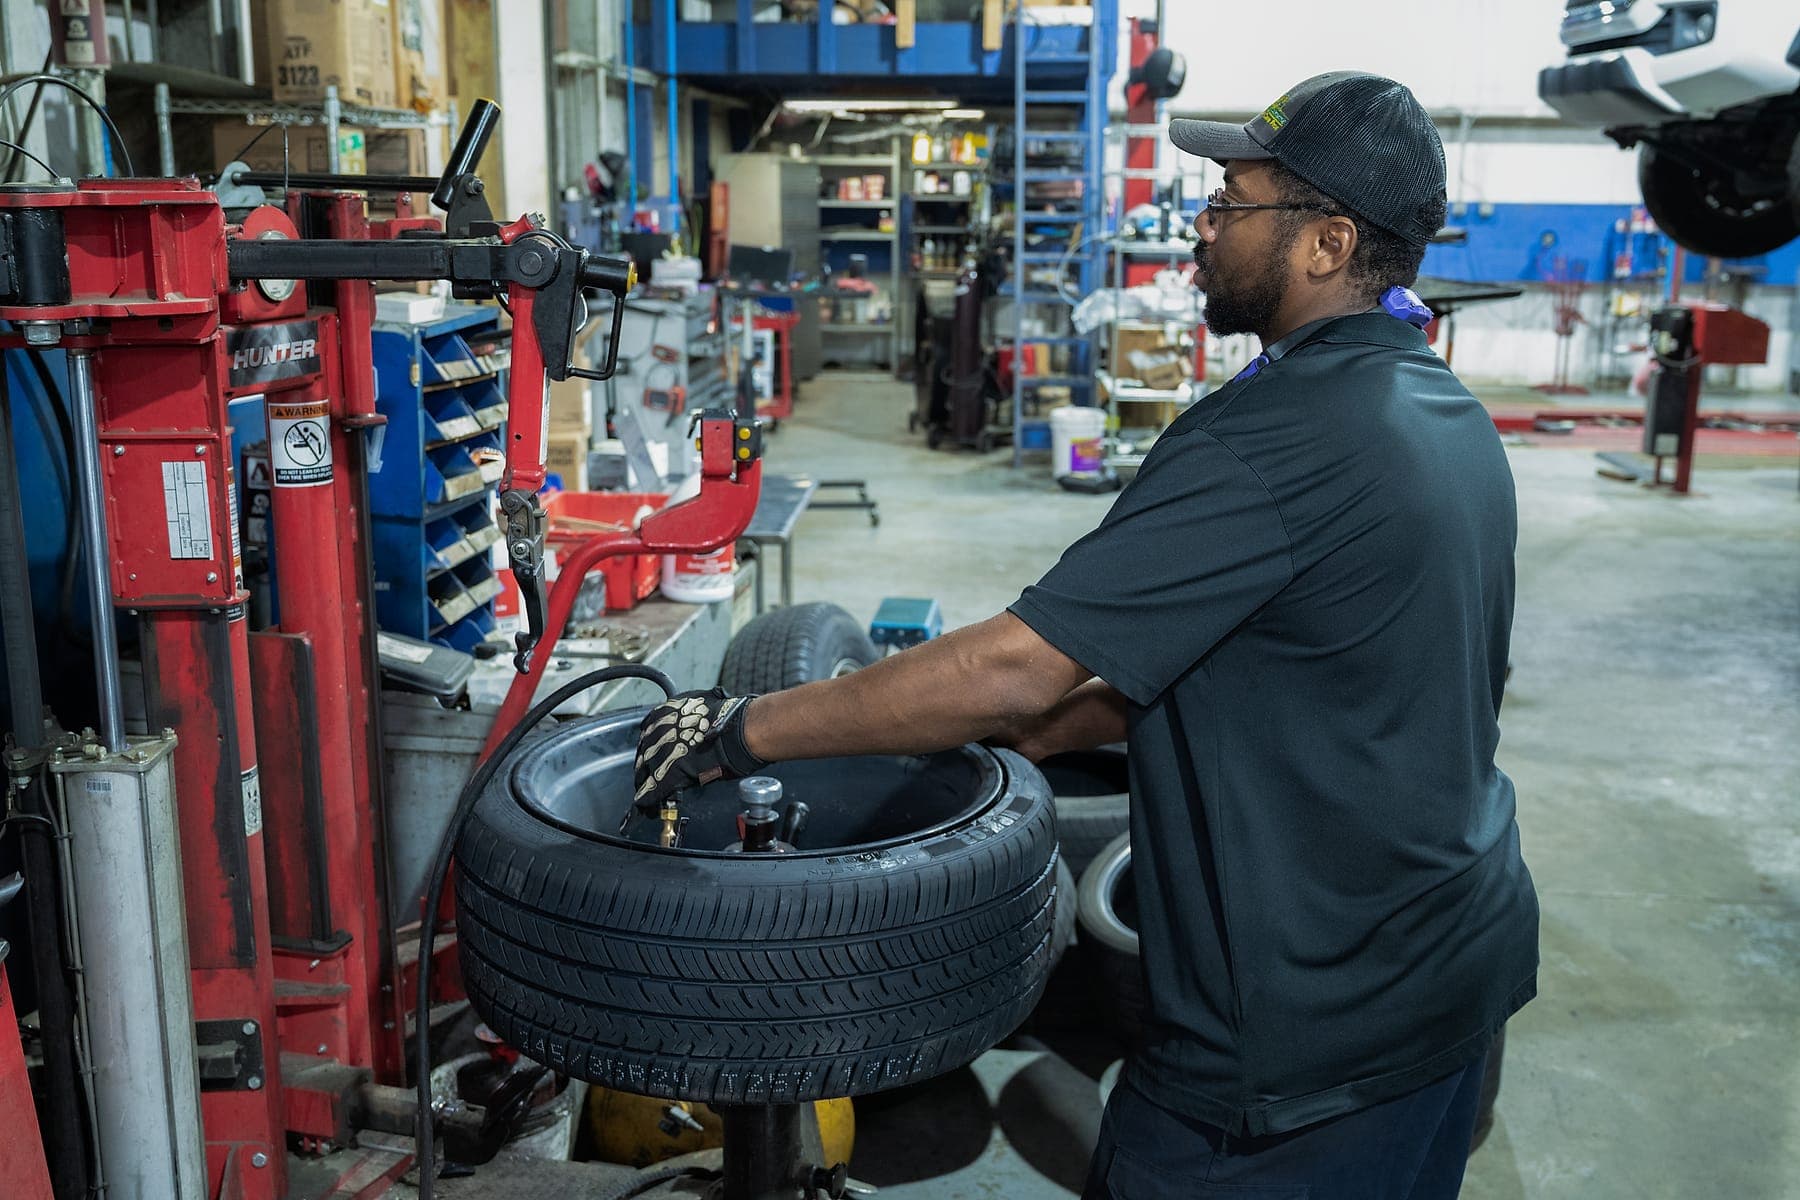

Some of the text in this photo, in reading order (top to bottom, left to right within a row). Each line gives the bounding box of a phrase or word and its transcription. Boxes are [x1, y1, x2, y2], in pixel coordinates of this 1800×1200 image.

[283, 42, 312, 60] ATF
[278, 65, 320, 87] 3123
[233, 339, 316, 370] HUNTER
[285, 404, 329, 417] WARNING
[519, 1030, 690, 1090] 245/35R20
[721, 1071, 813, 1093] T257
